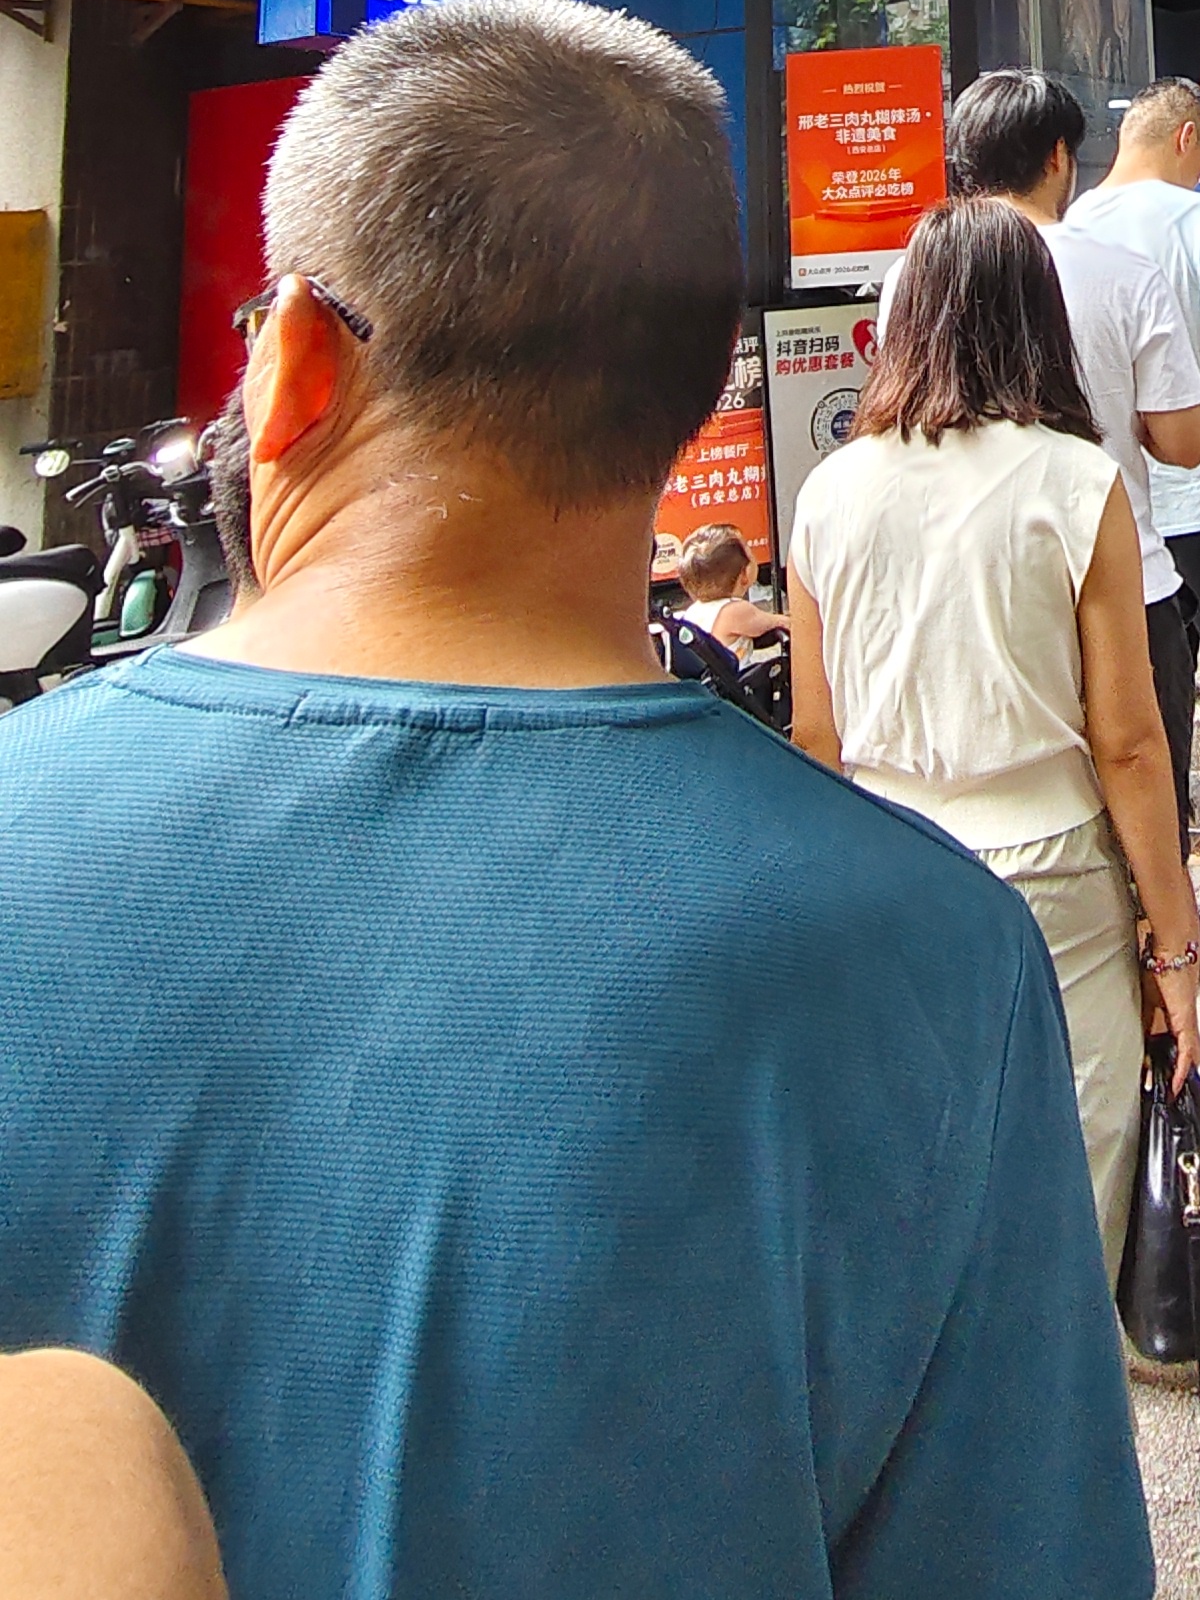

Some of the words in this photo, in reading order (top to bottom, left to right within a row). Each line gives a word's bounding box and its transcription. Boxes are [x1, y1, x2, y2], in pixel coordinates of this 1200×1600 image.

[835, 126, 897, 144] 非遗美食
[831, 168, 902, 185] 荣登2026年
[822, 182, 914, 201] 大众点评必吃榜
[776, 336, 840, 357] 抖音扫码
[775, 352, 855, 376] 购优惠套餐
[697, 443, 750, 463] 上榜餐厅
